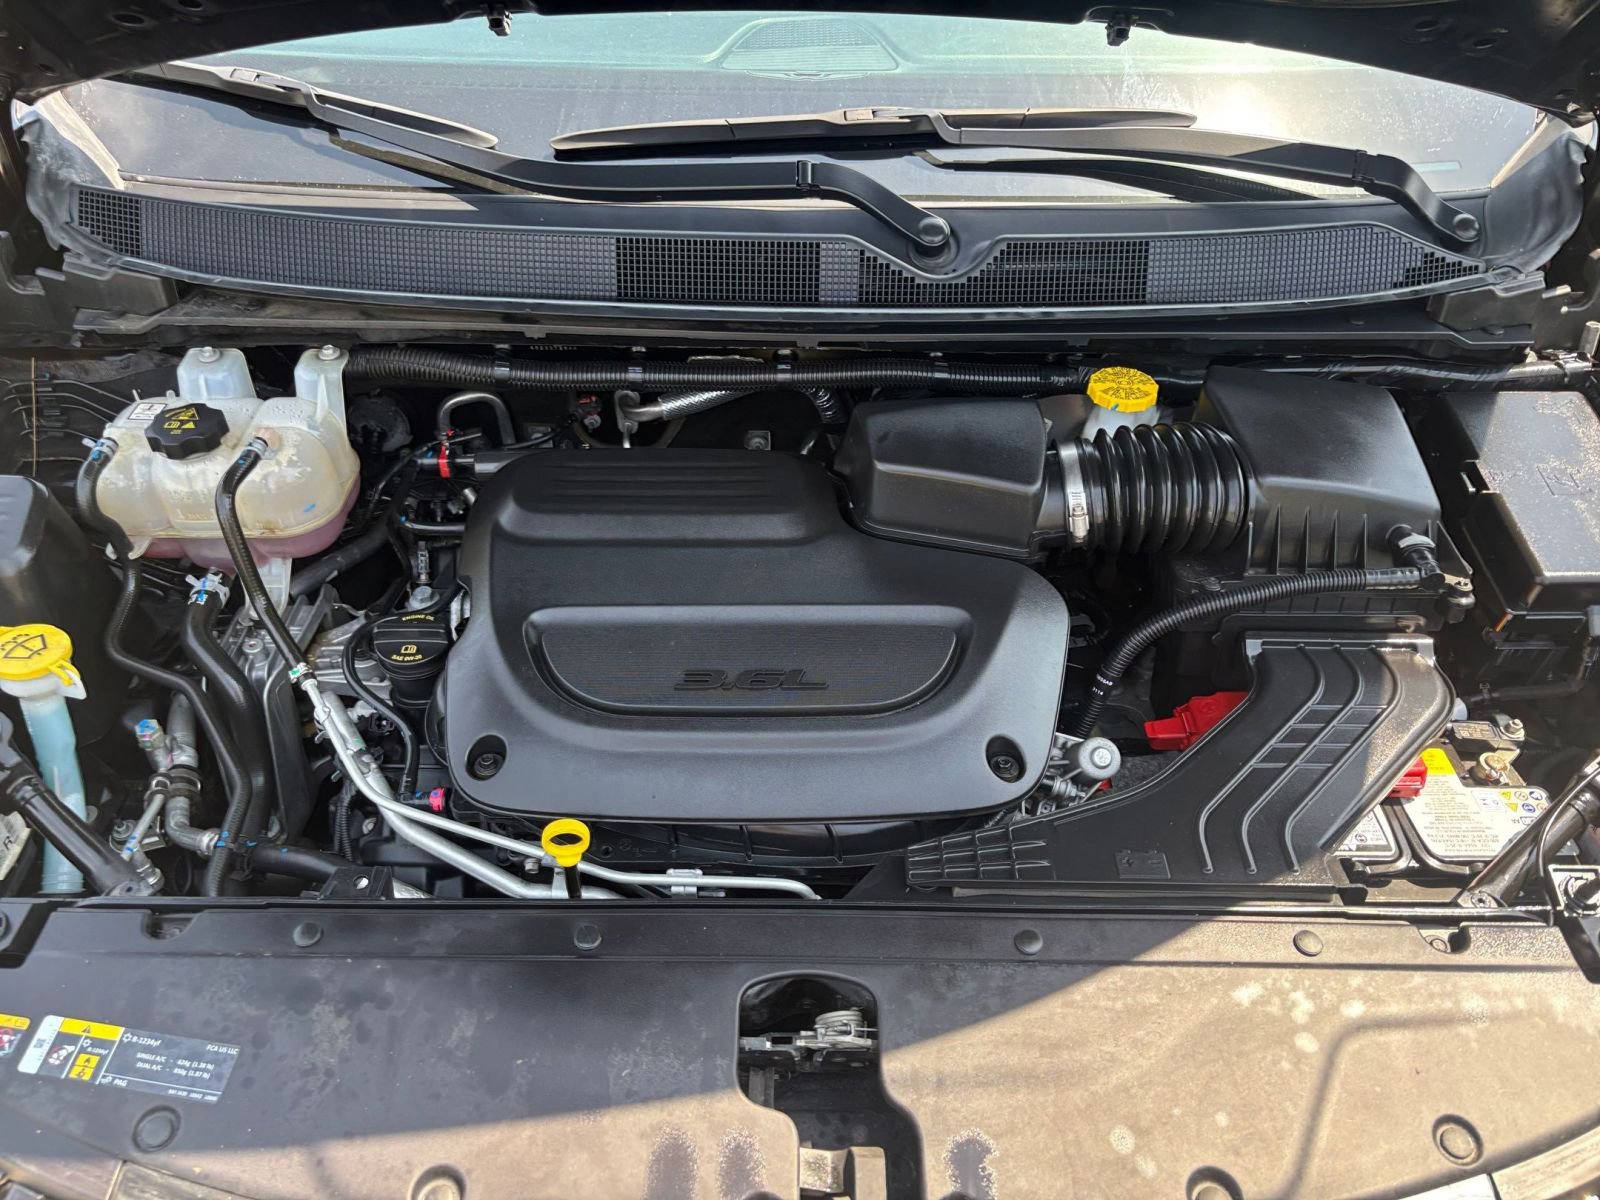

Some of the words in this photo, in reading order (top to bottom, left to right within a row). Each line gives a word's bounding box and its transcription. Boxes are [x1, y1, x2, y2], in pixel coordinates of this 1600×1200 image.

[674, 668, 830, 691] 3.6L
[131, 1036, 162, 1047] R-1234yf
[206, 1043, 219, 1052] FCA
[219, 1045, 228, 1053] US
[227, 1046, 240, 1055] LLC
[113, 1079, 128, 1087] PAG
